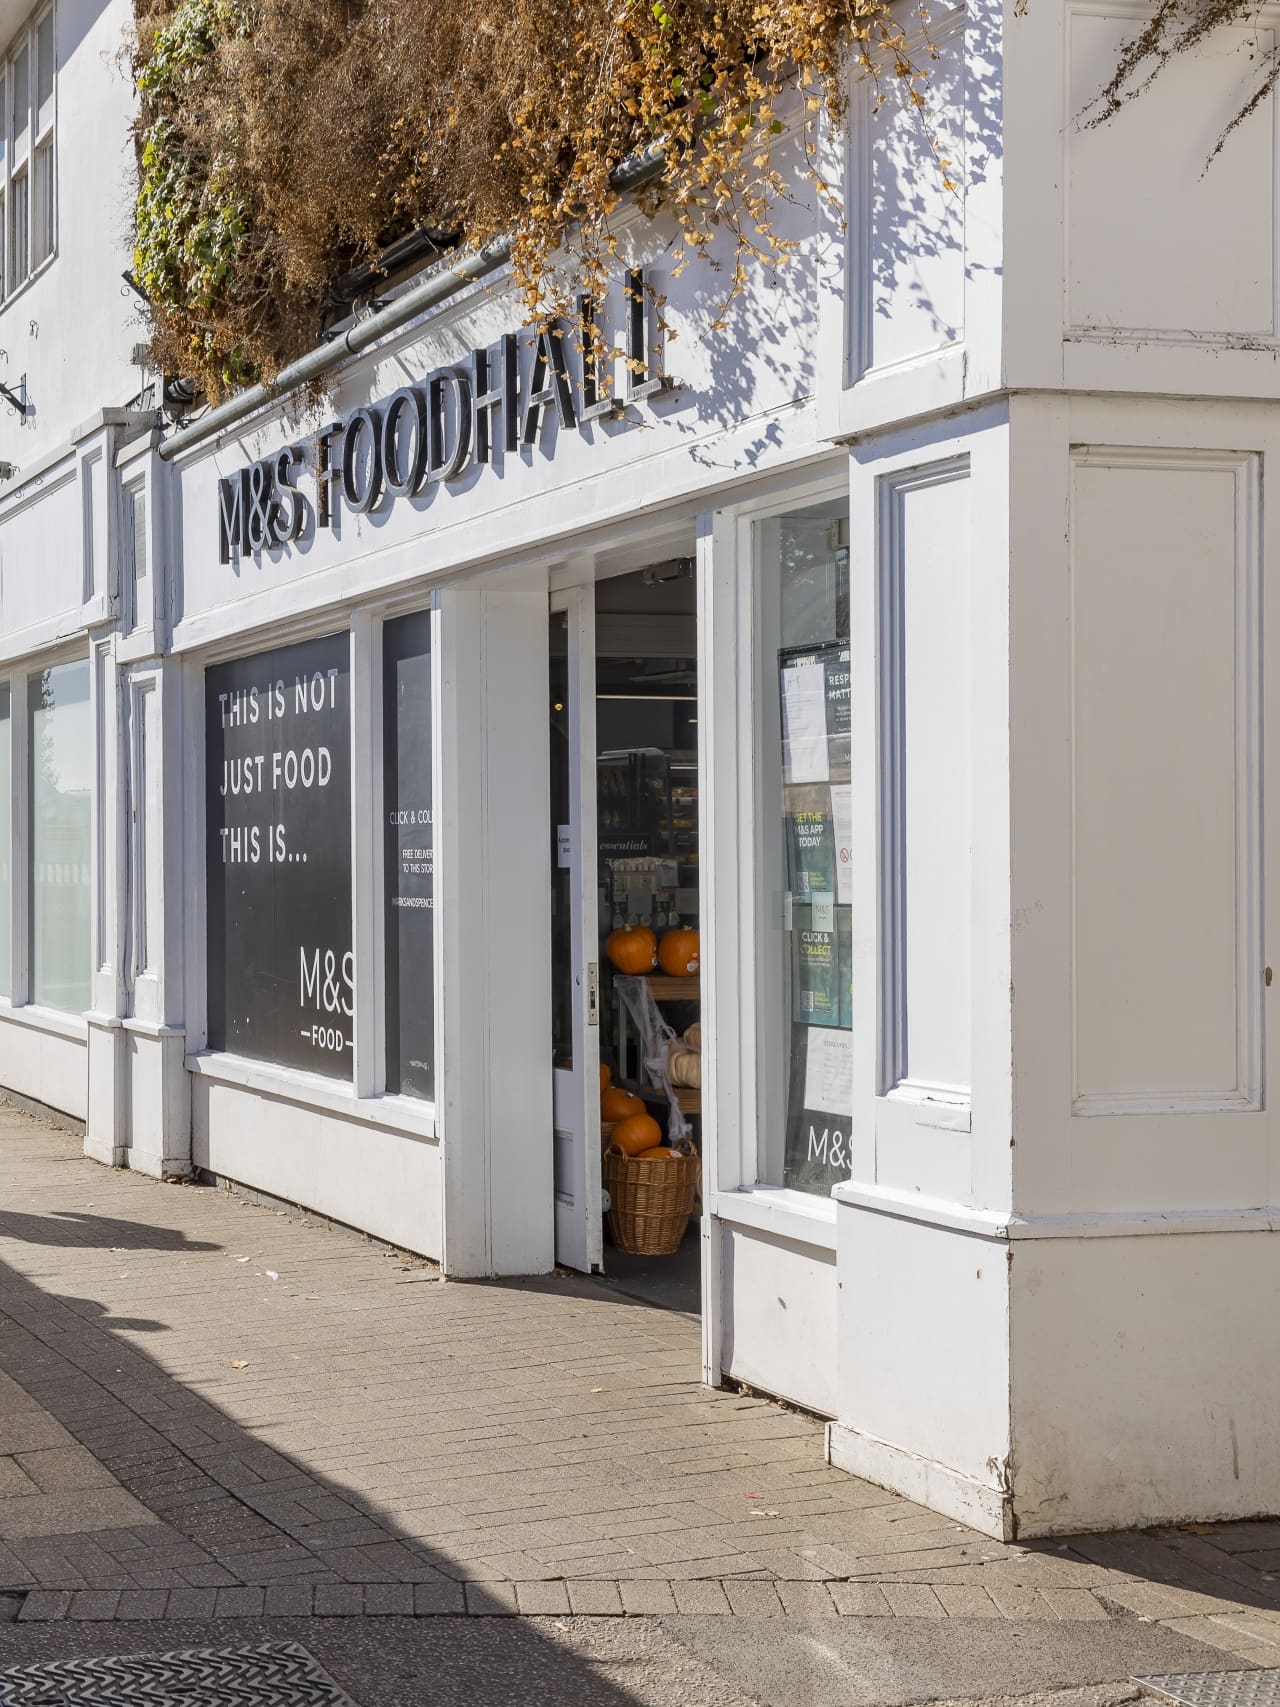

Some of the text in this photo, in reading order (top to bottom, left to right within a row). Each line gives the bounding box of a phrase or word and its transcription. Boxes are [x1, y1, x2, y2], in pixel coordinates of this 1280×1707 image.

[219, 268, 674, 564] M&S FOODHALL
[219, 668, 339, 729] THIS IS NOT
[220, 747, 332, 796] JUST FOOD
[390, 811, 409, 824] CLICK
[411, 811, 416, 824] &
[810, 824, 824, 834] APP
[220, 824, 308, 864] THIS IS...
[599, 839, 648, 851] essentials
[799, 837, 821, 847] TODAY
[402, 849, 414, 859] FREE
[402, 864, 409, 873] TO
[410, 864, 420, 873] THIS
[801, 932, 829, 943] CLICK &
[800, 945, 832, 955] COLLECT
[299, 946, 353, 1017] M&S
[807, 1125, 853, 1169] M&
